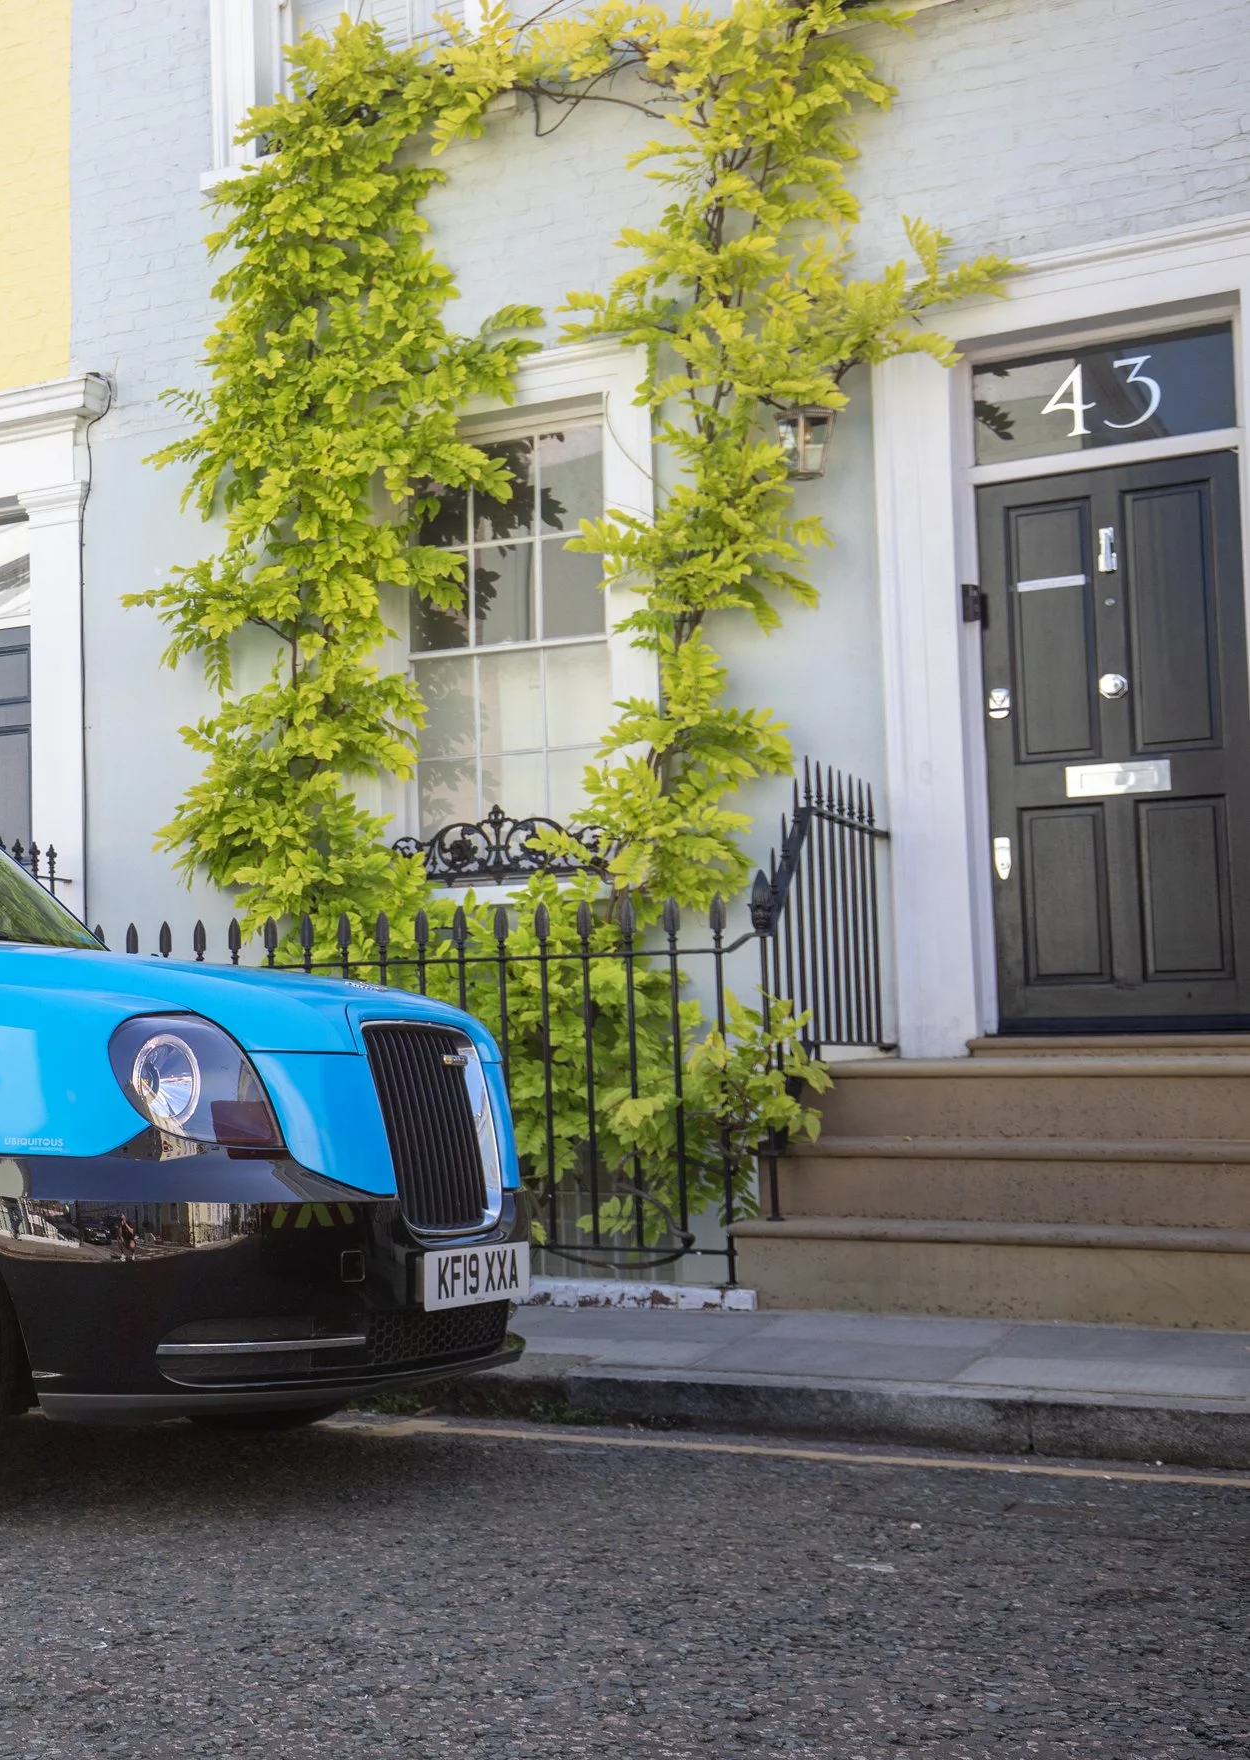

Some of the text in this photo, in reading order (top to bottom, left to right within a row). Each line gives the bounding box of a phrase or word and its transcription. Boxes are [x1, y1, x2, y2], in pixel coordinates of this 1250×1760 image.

[1041, 355, 1162, 437] 43
[4, 1137, 64, 1146] UBIQUITOUS
[438, 1248, 519, 1299] KF19 XXA
